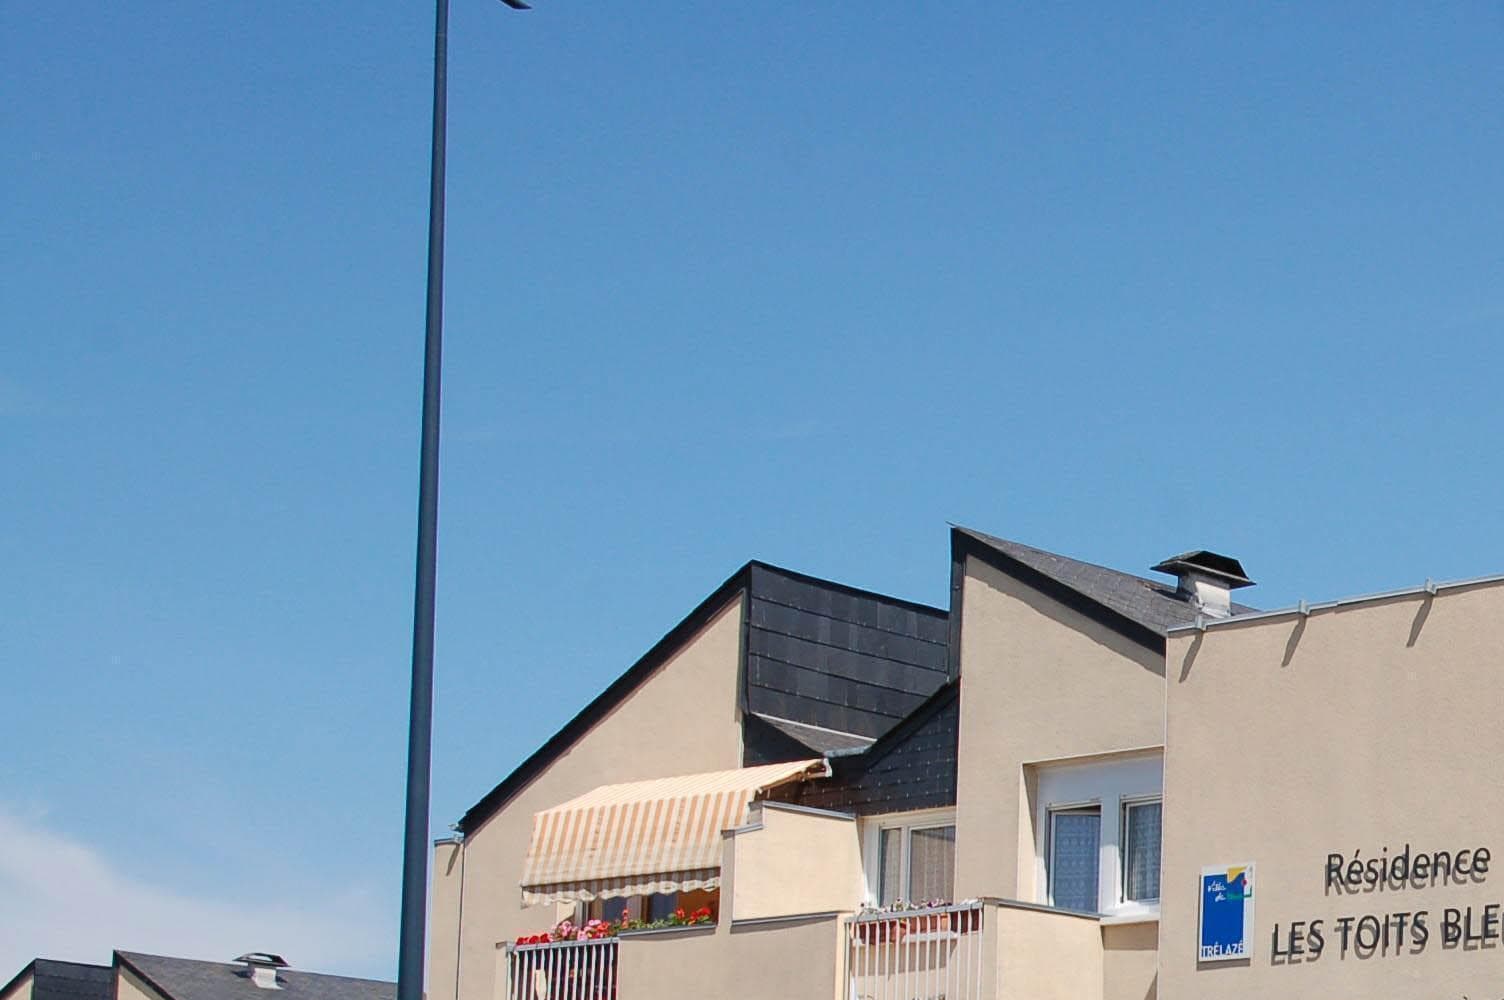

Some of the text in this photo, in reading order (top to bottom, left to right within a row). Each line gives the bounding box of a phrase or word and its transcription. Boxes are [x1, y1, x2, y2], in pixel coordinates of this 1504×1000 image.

[1326, 843, 1491, 887] Résidence
[1274, 919, 1324, 956] LES
[1337, 911, 1429, 951] TOITS
